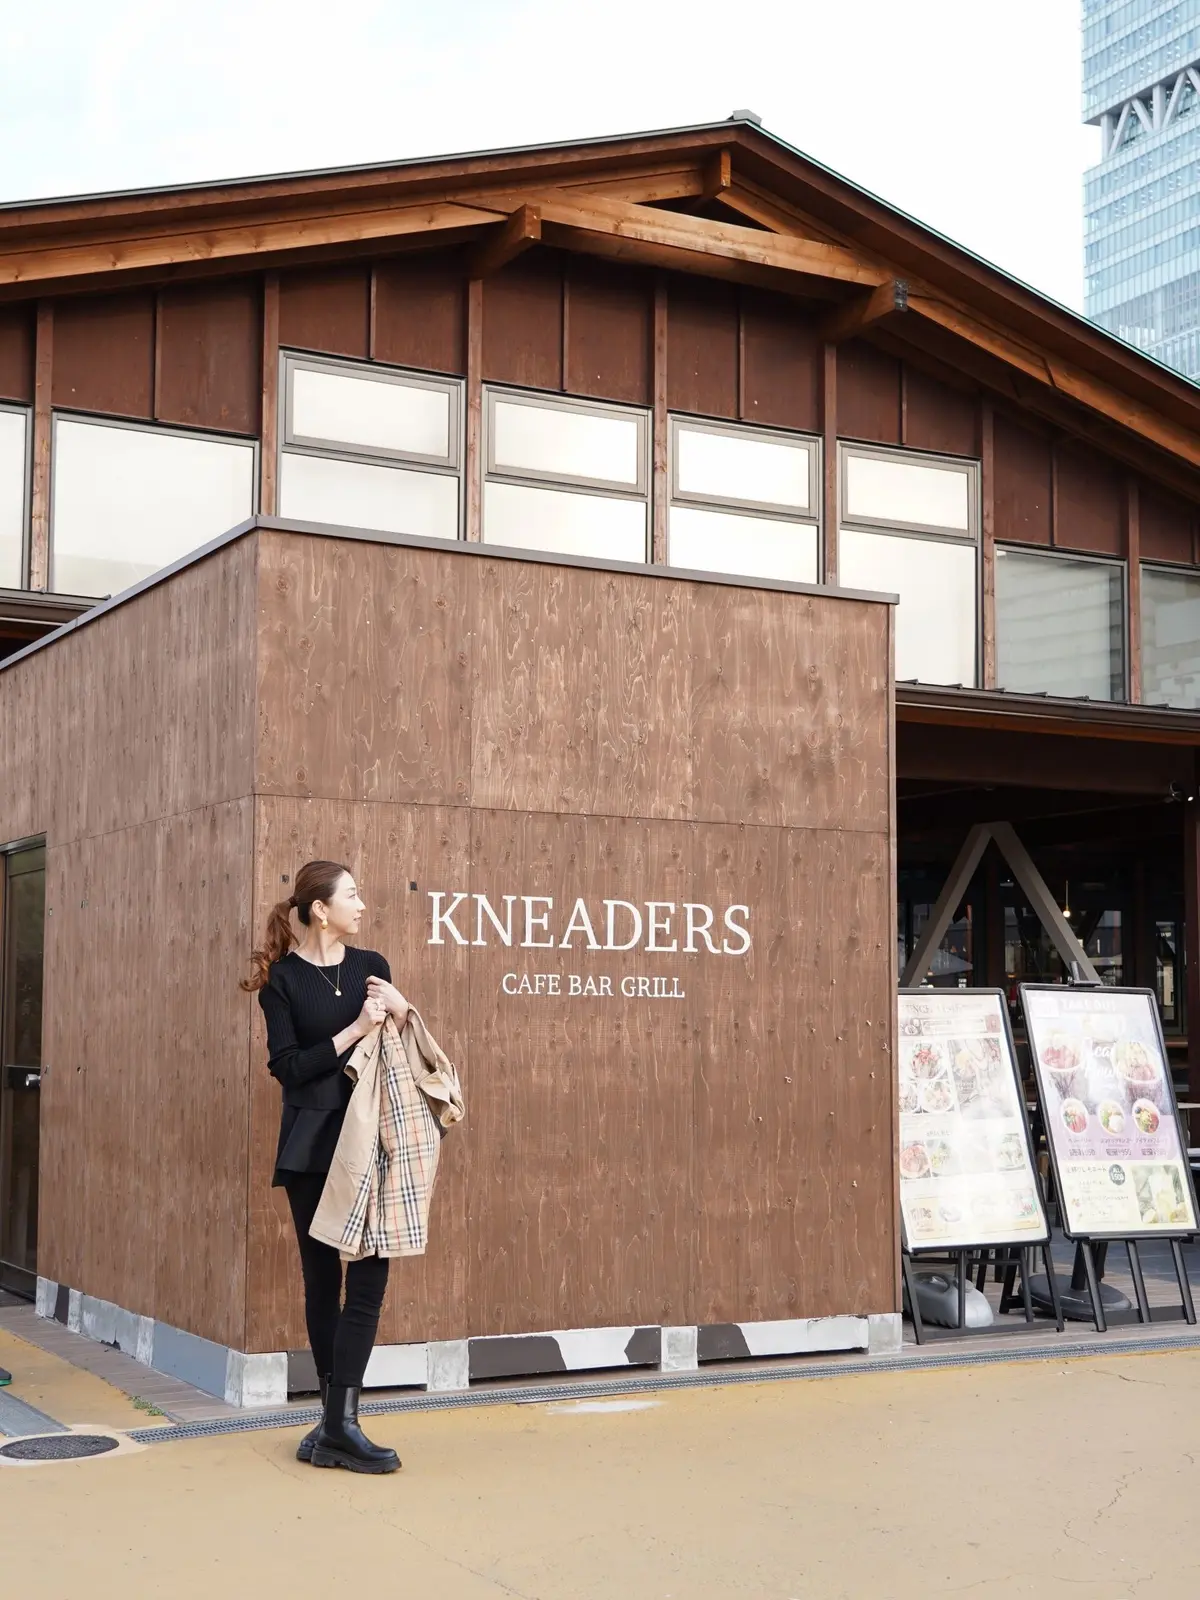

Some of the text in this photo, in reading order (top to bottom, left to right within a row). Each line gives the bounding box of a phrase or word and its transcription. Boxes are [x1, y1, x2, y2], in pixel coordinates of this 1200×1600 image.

[427, 891, 751, 955] KNEADERS
[502, 973, 686, 998] CAFE BAR GRILL
